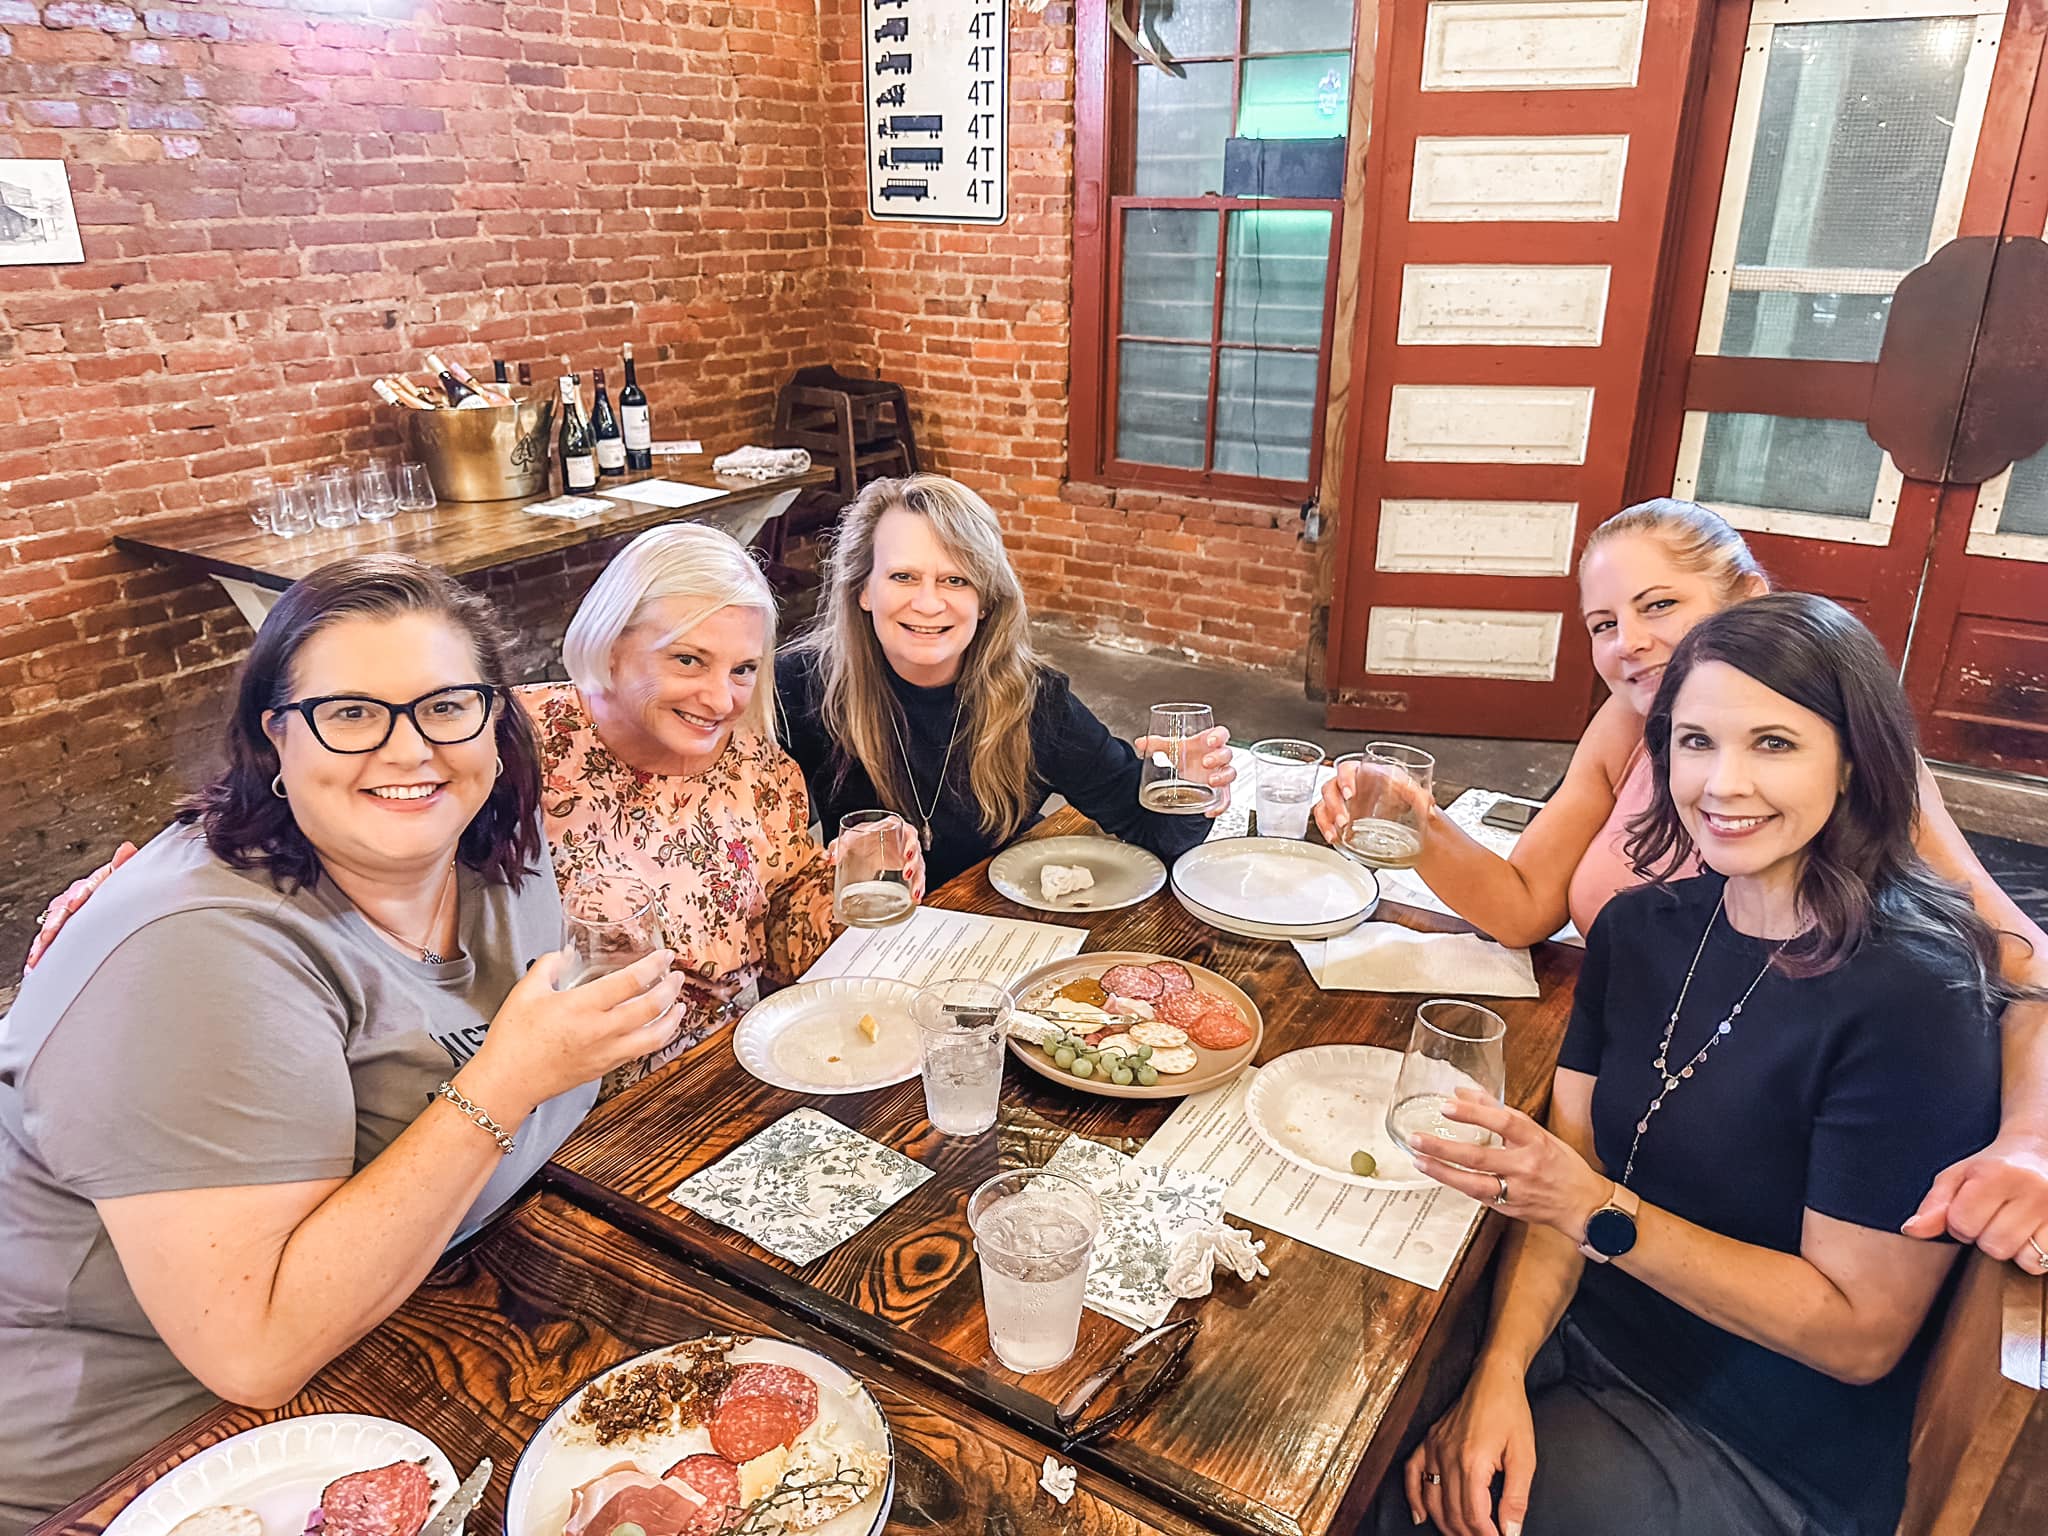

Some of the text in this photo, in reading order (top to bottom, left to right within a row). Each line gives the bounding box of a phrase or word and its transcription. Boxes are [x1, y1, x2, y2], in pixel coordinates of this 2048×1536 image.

[968, 12, 995, 40] 4T
[967, 46, 995, 72] 4T
[967, 80, 995, 106] 4T
[967, 114, 995, 139] 4T
[967, 146, 995, 172] 4T
[966, 179, 995, 204] 4T
